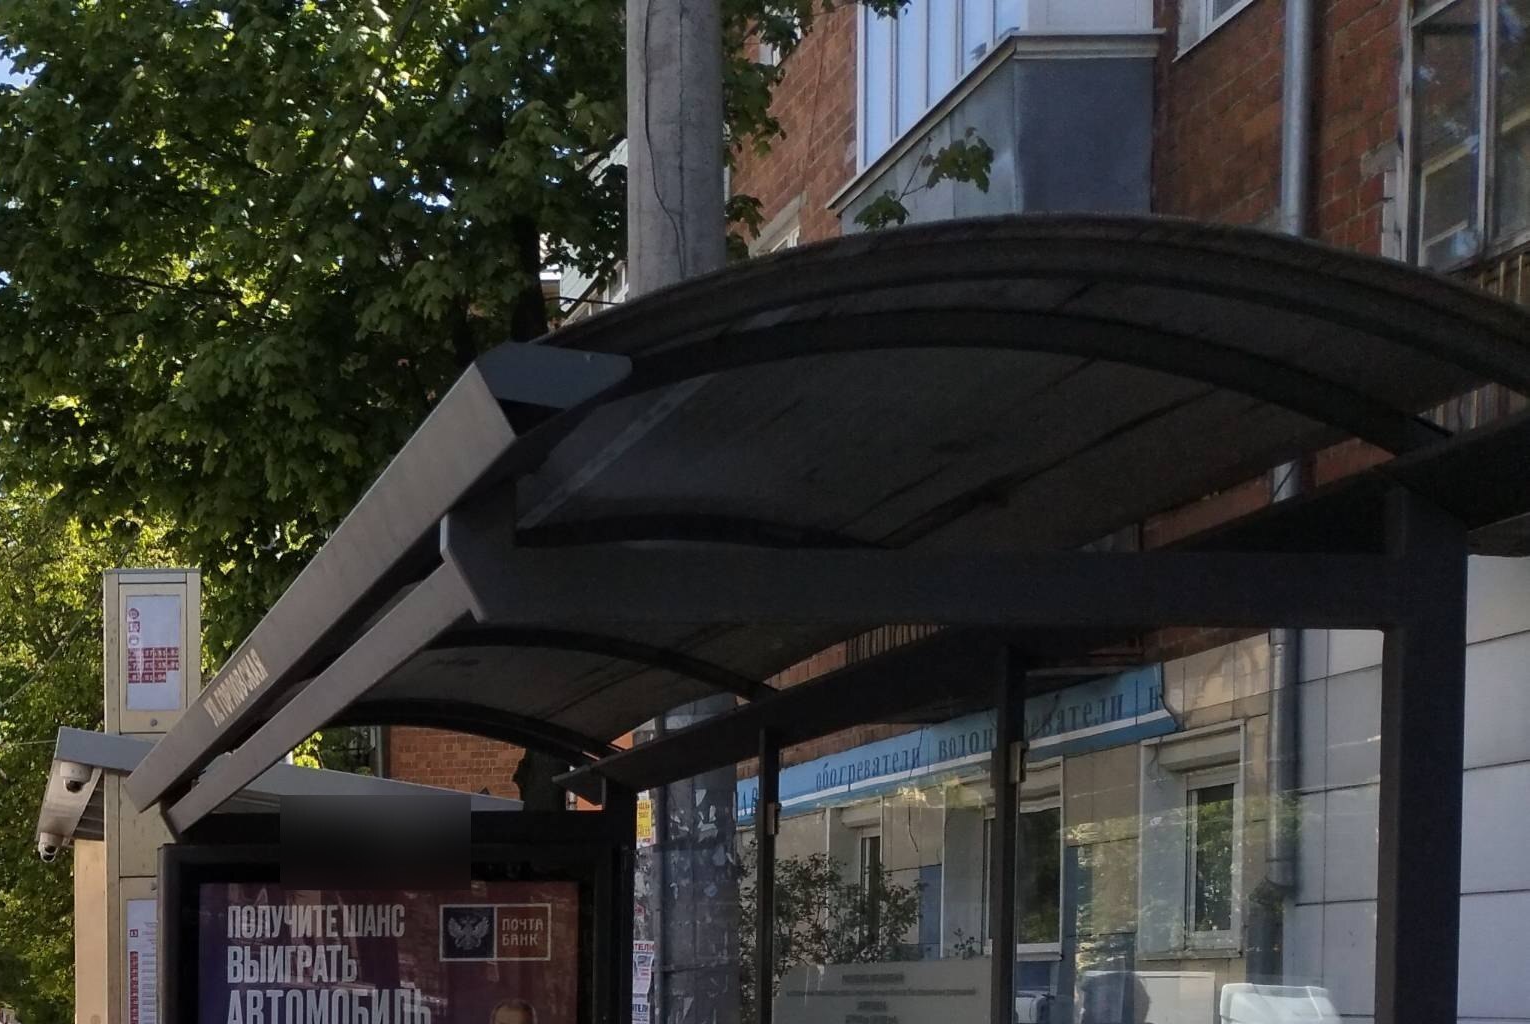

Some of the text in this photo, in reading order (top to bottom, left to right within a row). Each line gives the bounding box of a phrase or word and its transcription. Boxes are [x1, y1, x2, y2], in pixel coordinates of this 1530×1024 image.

[815, 747, 921, 792] обогреватели
[227, 904, 406, 938] ПОЛУЧИТЕ ШАНС
[502, 918, 544, 931] ПОЧТА
[502, 934, 538, 946] БАНК
[227, 945, 358, 984] ВЫИГРАТЬ
